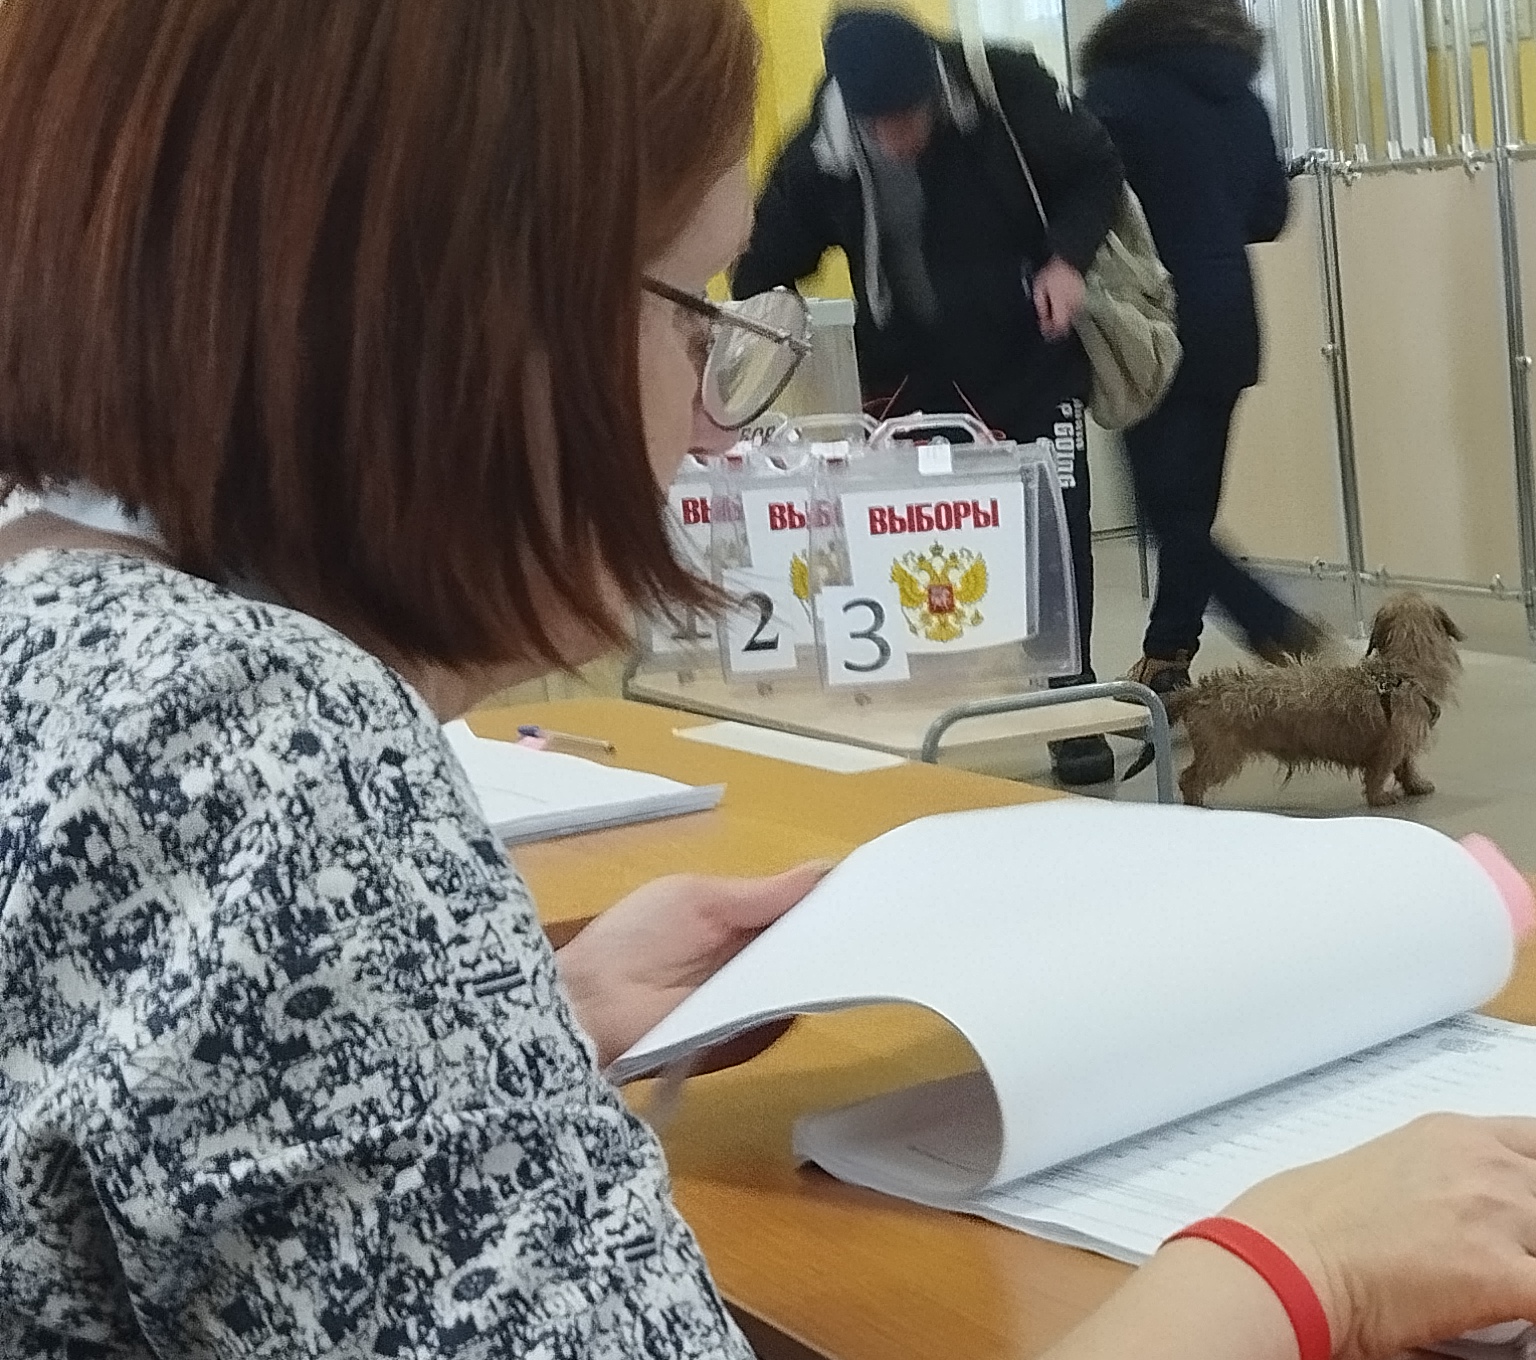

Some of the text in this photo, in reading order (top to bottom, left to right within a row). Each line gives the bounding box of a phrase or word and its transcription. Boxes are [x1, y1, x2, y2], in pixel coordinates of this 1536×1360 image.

[868, 497, 1000, 535] ВЫБОРЫ
[742, 592, 780, 652] 2
[842, 598, 891, 672] 3
